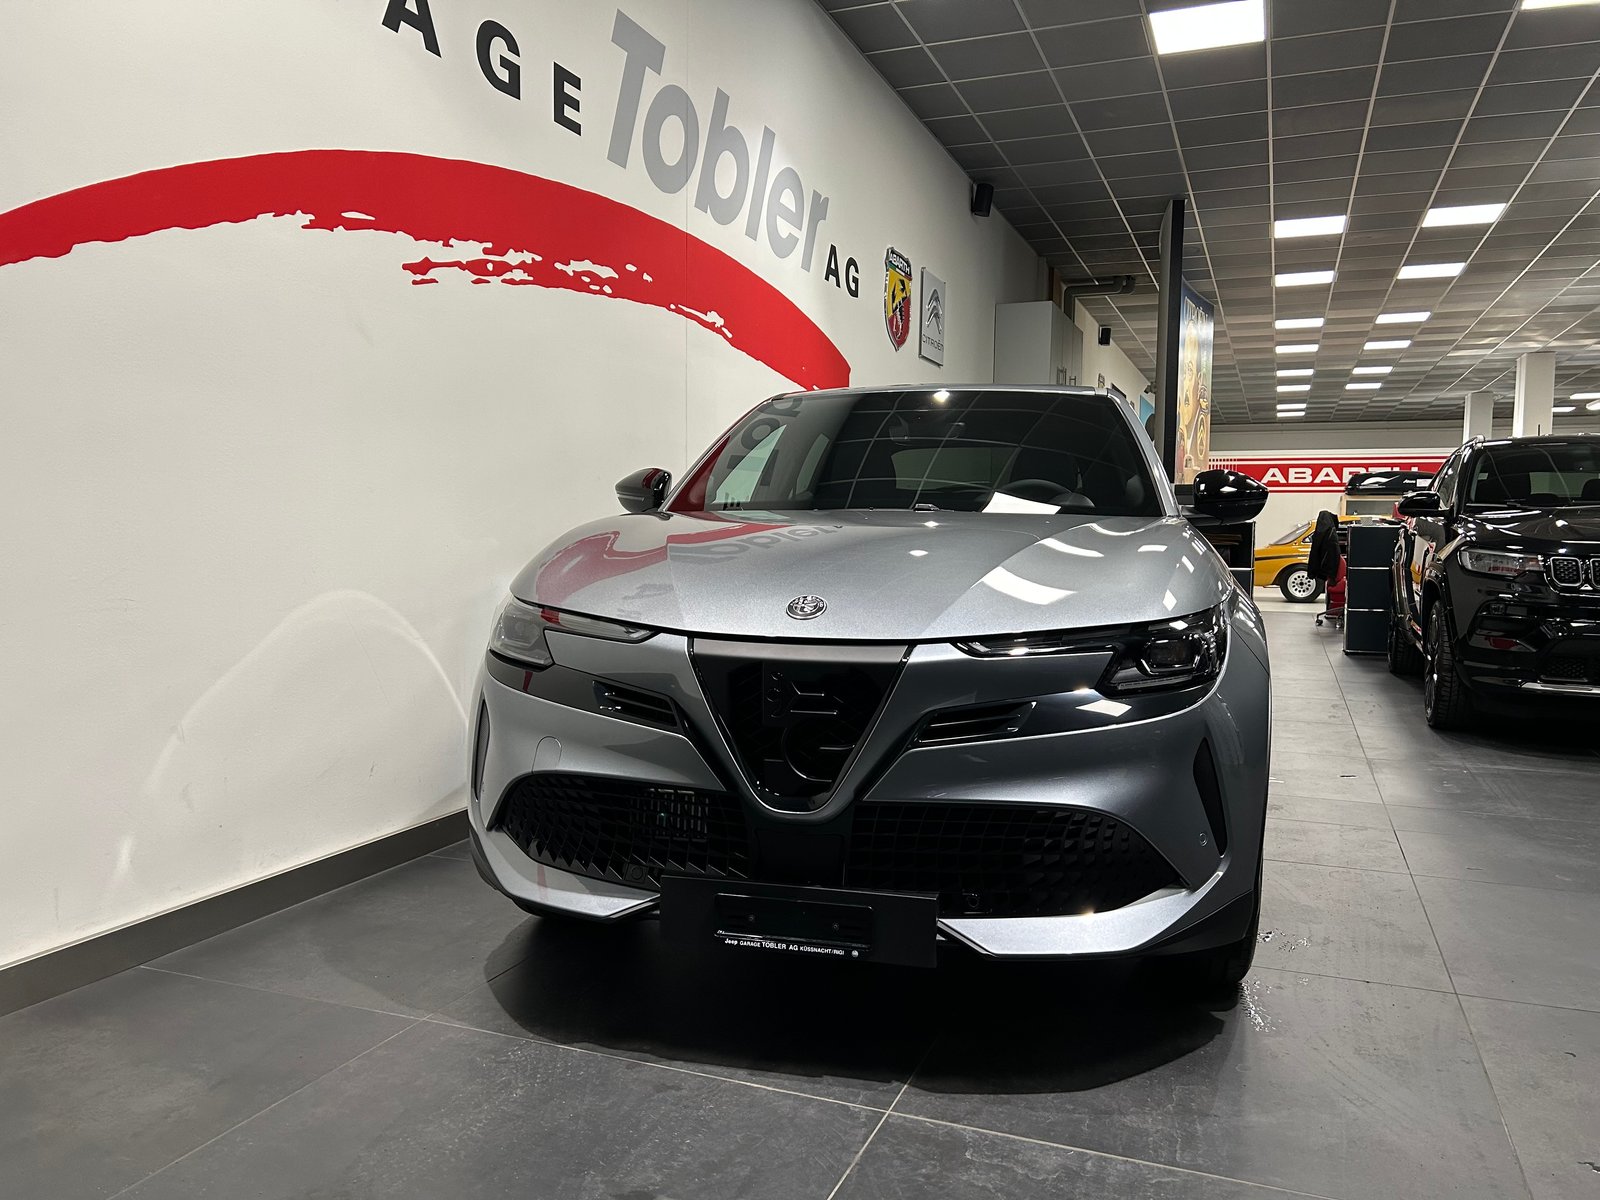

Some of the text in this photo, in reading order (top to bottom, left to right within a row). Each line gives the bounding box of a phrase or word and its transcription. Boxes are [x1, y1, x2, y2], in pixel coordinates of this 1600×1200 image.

[606, 8, 830, 273] Tobler
[824, 243, 859, 298] AG
[889, 252, 910, 275] ABARTH
[761, 941, 787, 950] TOBLER
